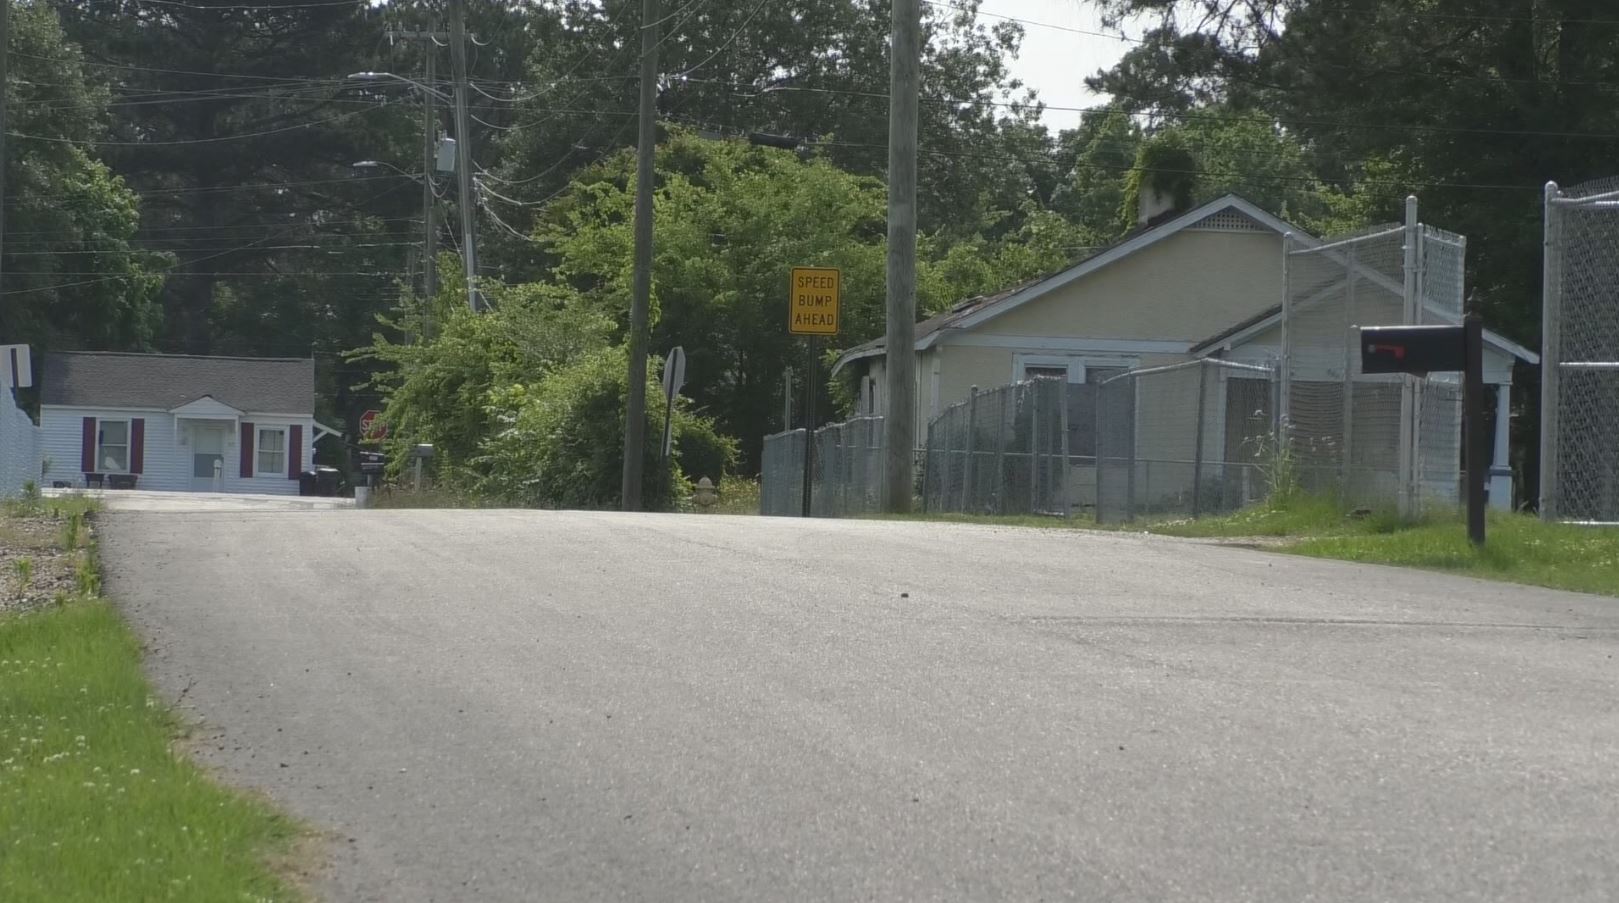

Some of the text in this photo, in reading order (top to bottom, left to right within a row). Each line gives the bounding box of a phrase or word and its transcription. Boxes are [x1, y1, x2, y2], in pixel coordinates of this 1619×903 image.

[798, 276, 834, 289] SPEED
[799, 294, 832, 307] BUMP
[795, 313, 834, 326] AHEAD
